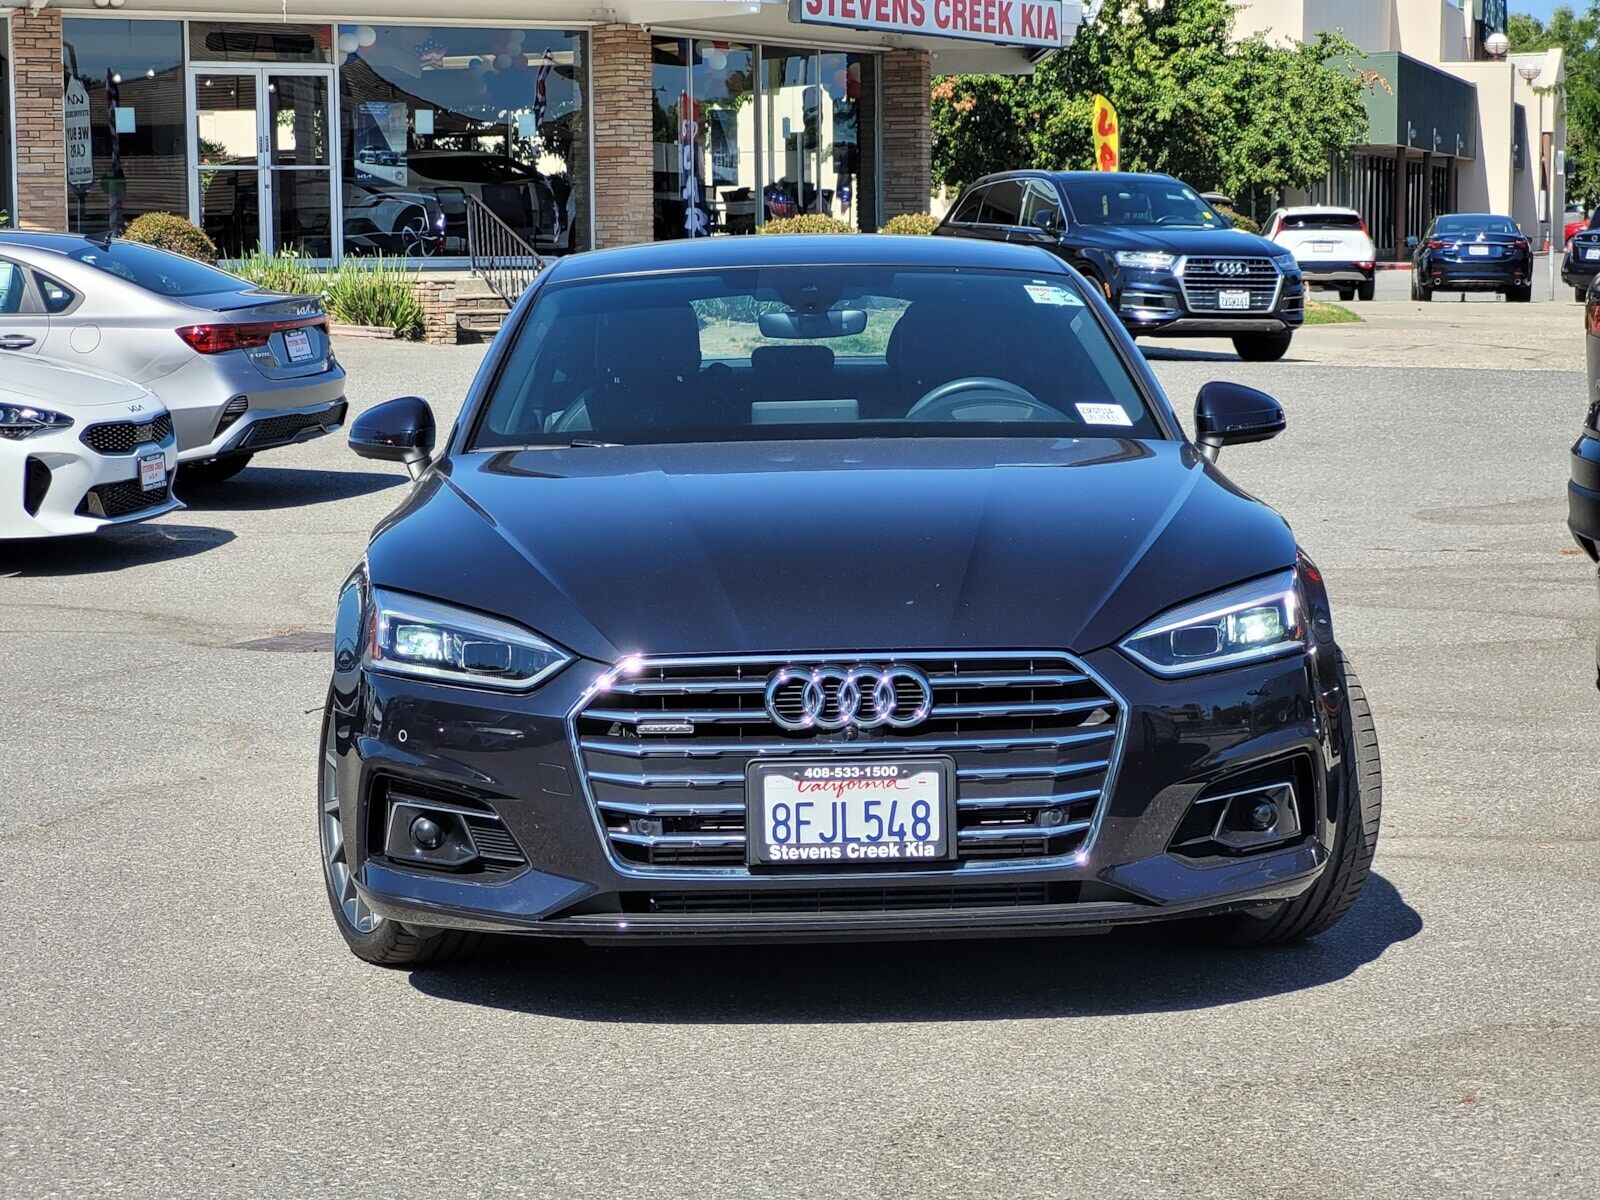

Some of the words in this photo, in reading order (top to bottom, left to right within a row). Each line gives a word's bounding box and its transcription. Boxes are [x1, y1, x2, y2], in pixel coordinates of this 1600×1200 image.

[934, 0, 1014, 35] CREEK
[1020, 3, 1059, 40] KIA
[804, 766, 898, 778] 408-533-1500
[797, 778, 910, 798] California
[771, 799, 931, 844] 8FJL548
[769, 844, 842, 860] Stevens
[846, 842, 901, 859] Creek
[904, 841, 935, 857] Kia
